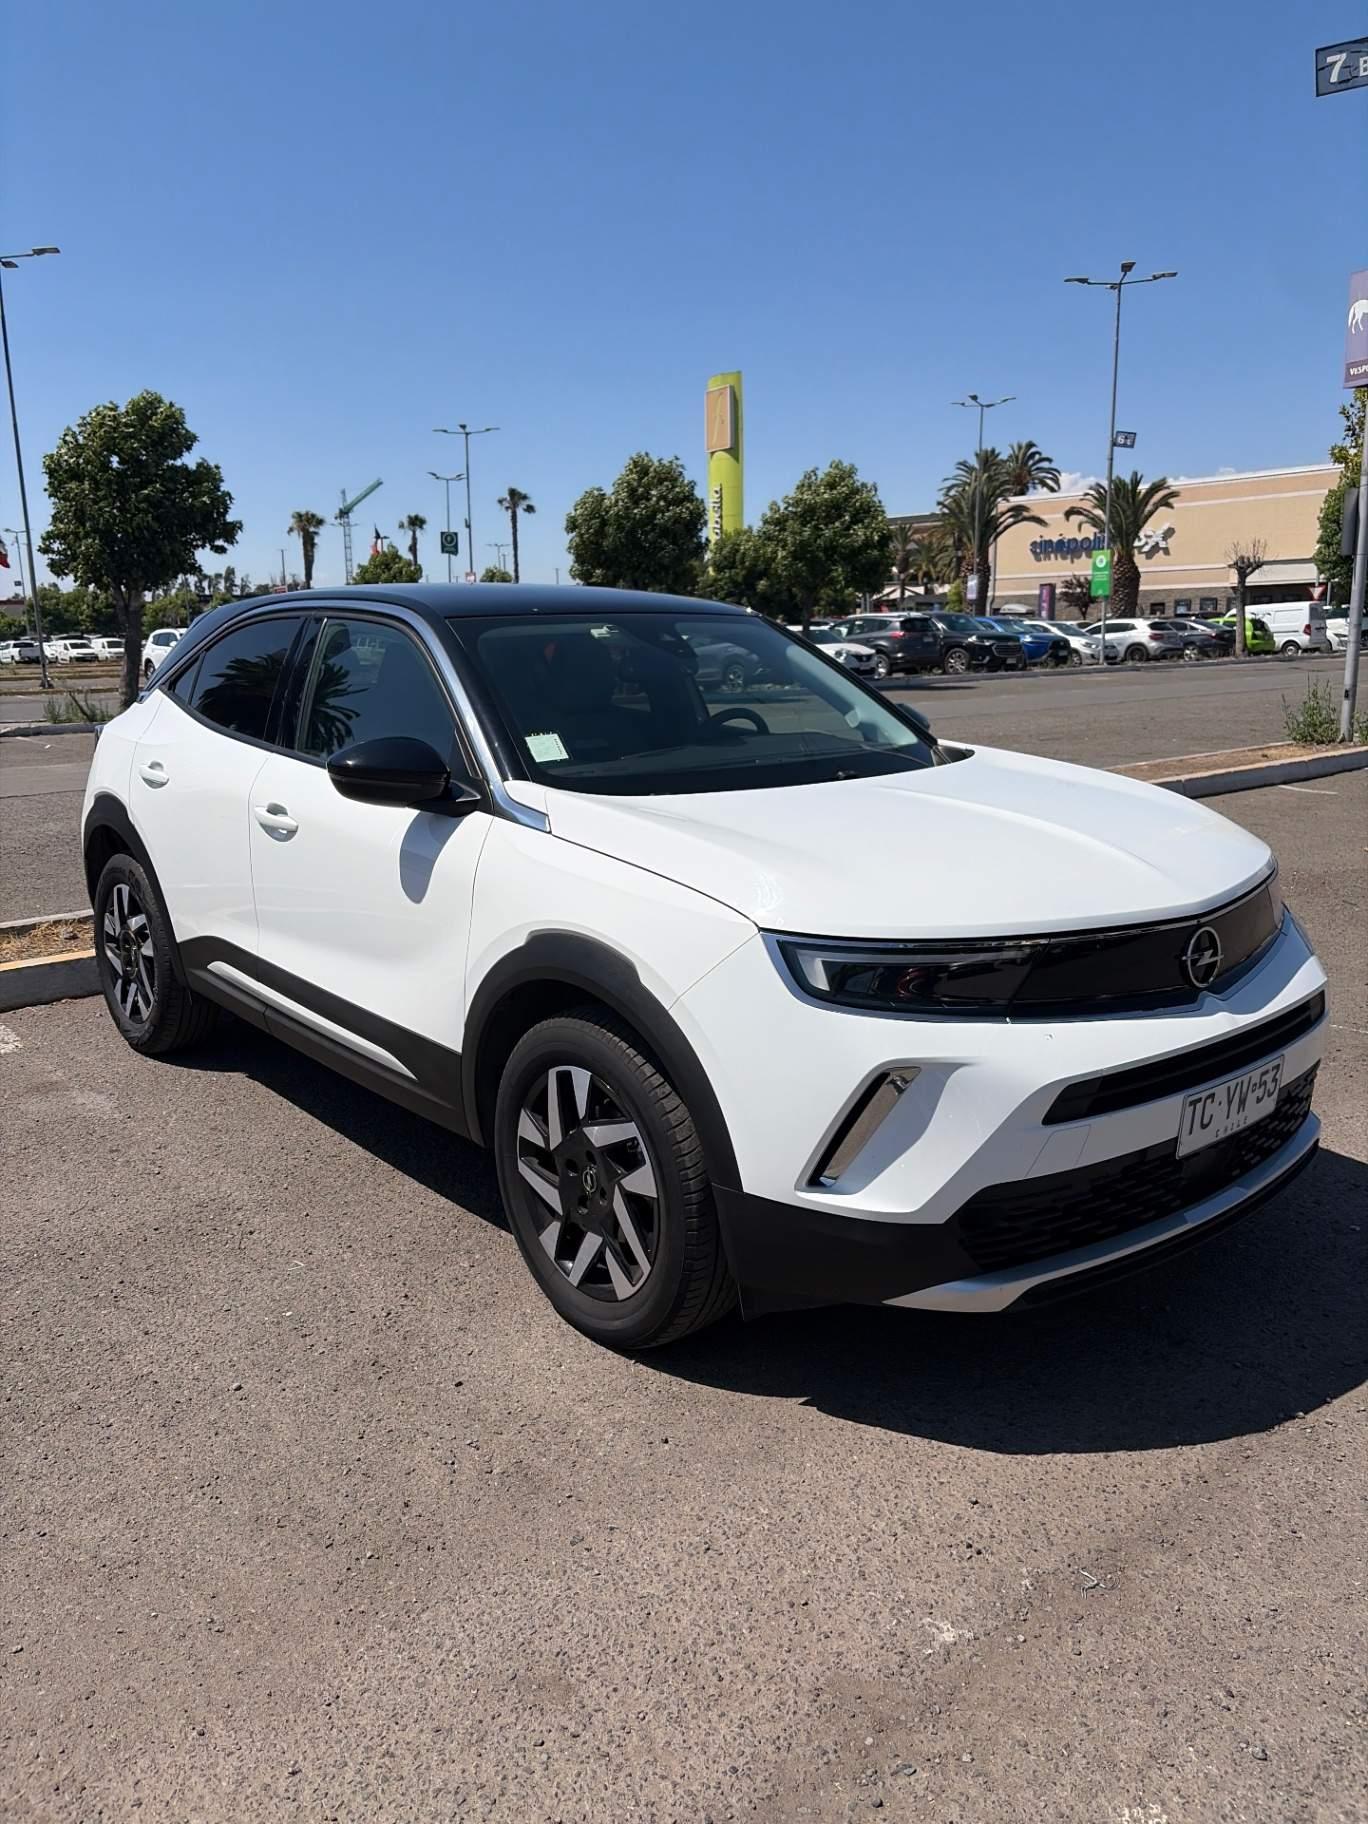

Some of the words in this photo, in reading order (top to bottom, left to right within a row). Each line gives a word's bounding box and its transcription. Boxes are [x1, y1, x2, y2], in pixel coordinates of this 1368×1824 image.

[1326, 52, 1347, 83] 7
[1029, 532, 1108, 556] cinépoli
[1215, 1115, 1248, 1138] CHILE
